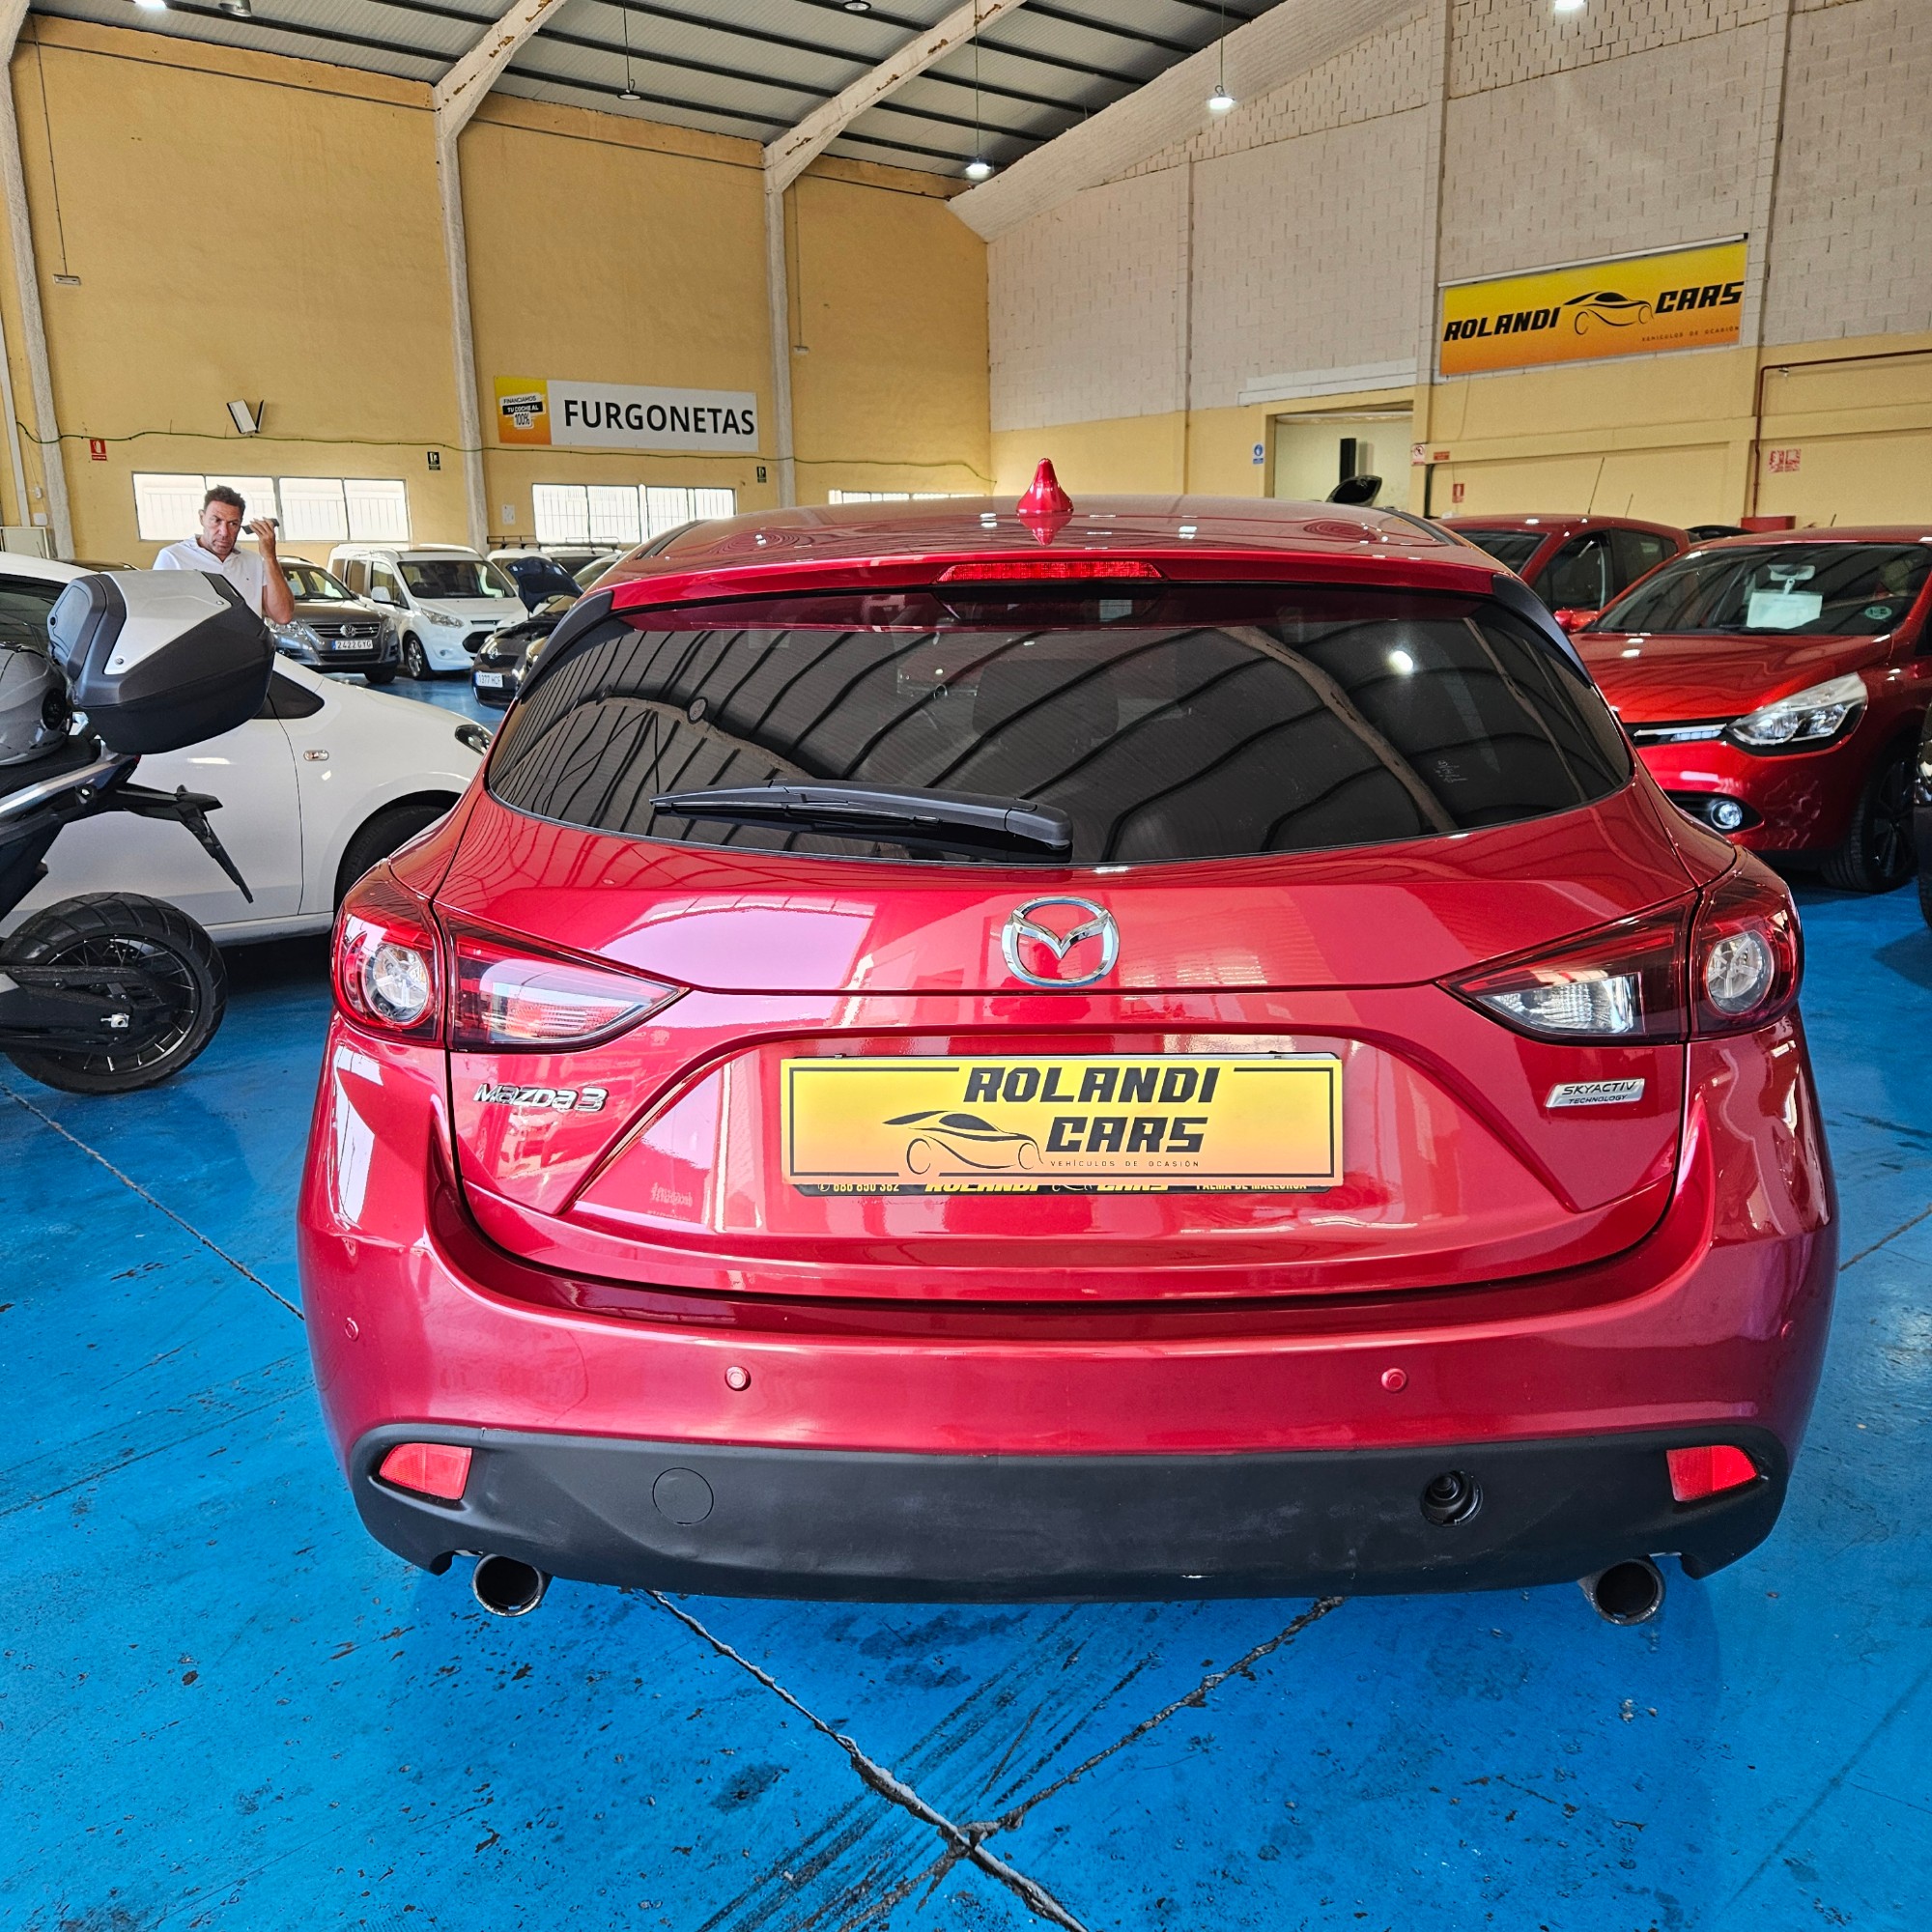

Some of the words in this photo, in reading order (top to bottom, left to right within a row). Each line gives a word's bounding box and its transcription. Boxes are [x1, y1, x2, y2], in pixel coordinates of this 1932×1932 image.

[1443, 306, 1561, 342] ROLANDI
[1655, 281, 1745, 314] CARS
[503, 395, 537, 404] FINANCIAMOS
[514, 412, 530, 425] 100%
[564, 399, 755, 436] FURGONETAS
[963, 1066, 1220, 1103] ROLANDI
[1562, 1082, 1636, 1094] SKYACTIV
[1569, 1094, 1629, 1104] TECHNOLOGY
[1046, 1117, 1208, 1153] CARS
